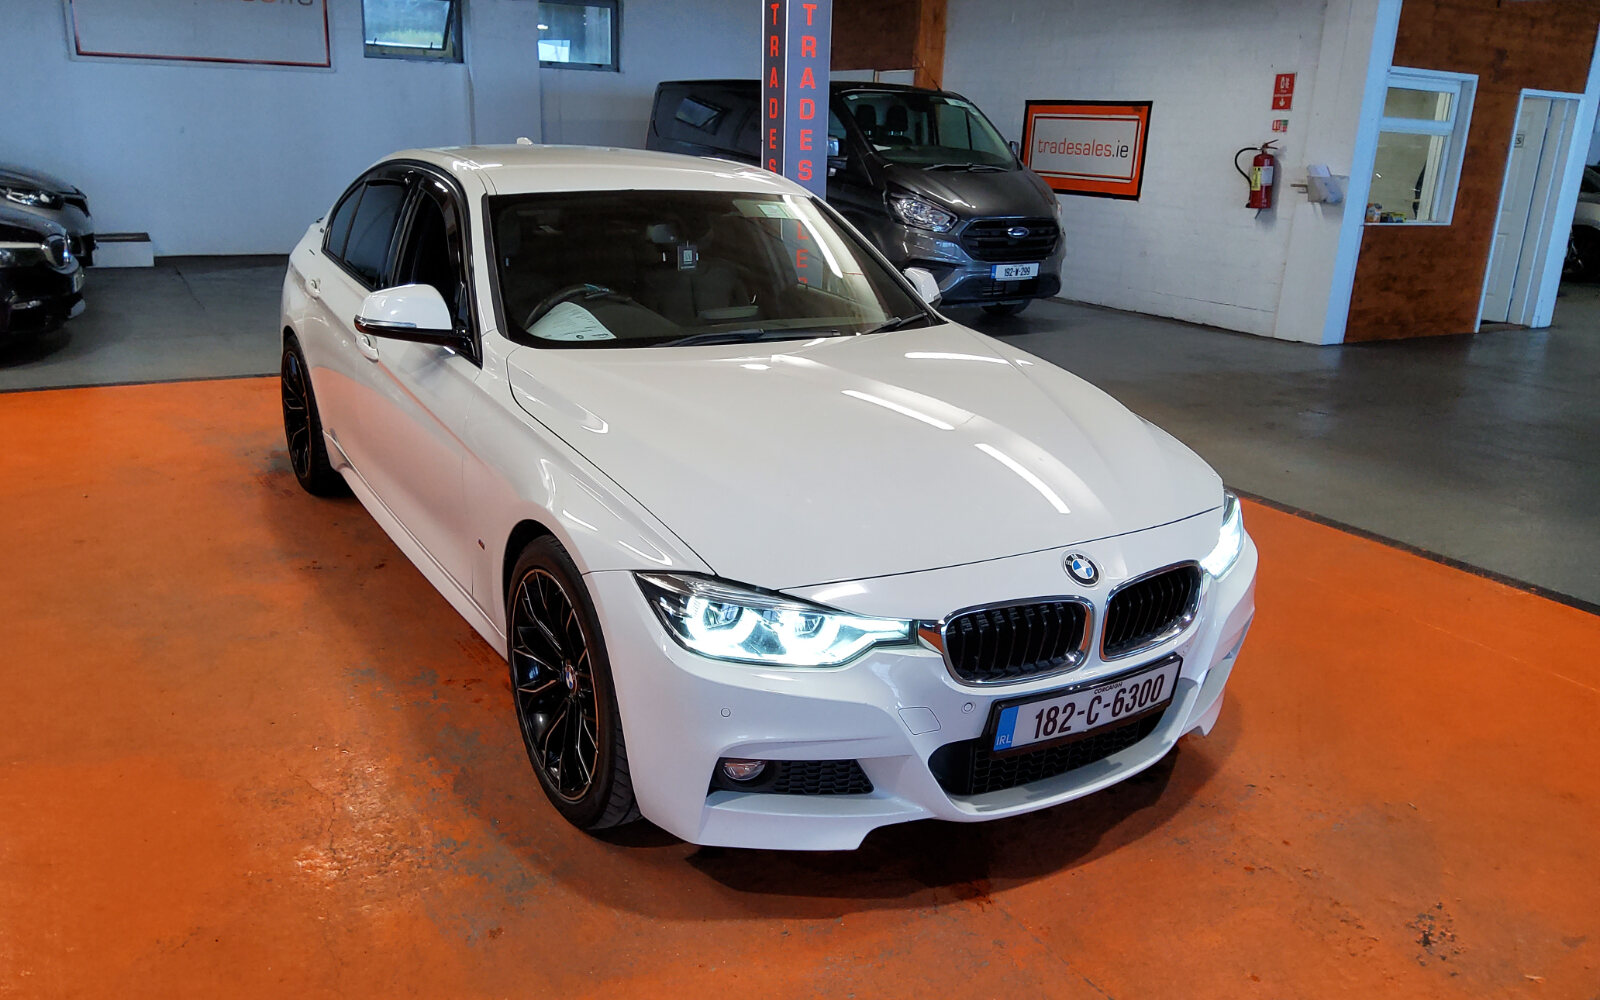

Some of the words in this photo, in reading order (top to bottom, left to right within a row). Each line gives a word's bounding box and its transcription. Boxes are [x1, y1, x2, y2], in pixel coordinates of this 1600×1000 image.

[768, 3, 780, 174] TRADES
[798, 3, 818, 181] TRADES
[1037, 137, 1130, 158] tradesales.ie
[996, 734, 1012, 746] IRL
[1034, 674, 1165, 740] 182-C-6300
